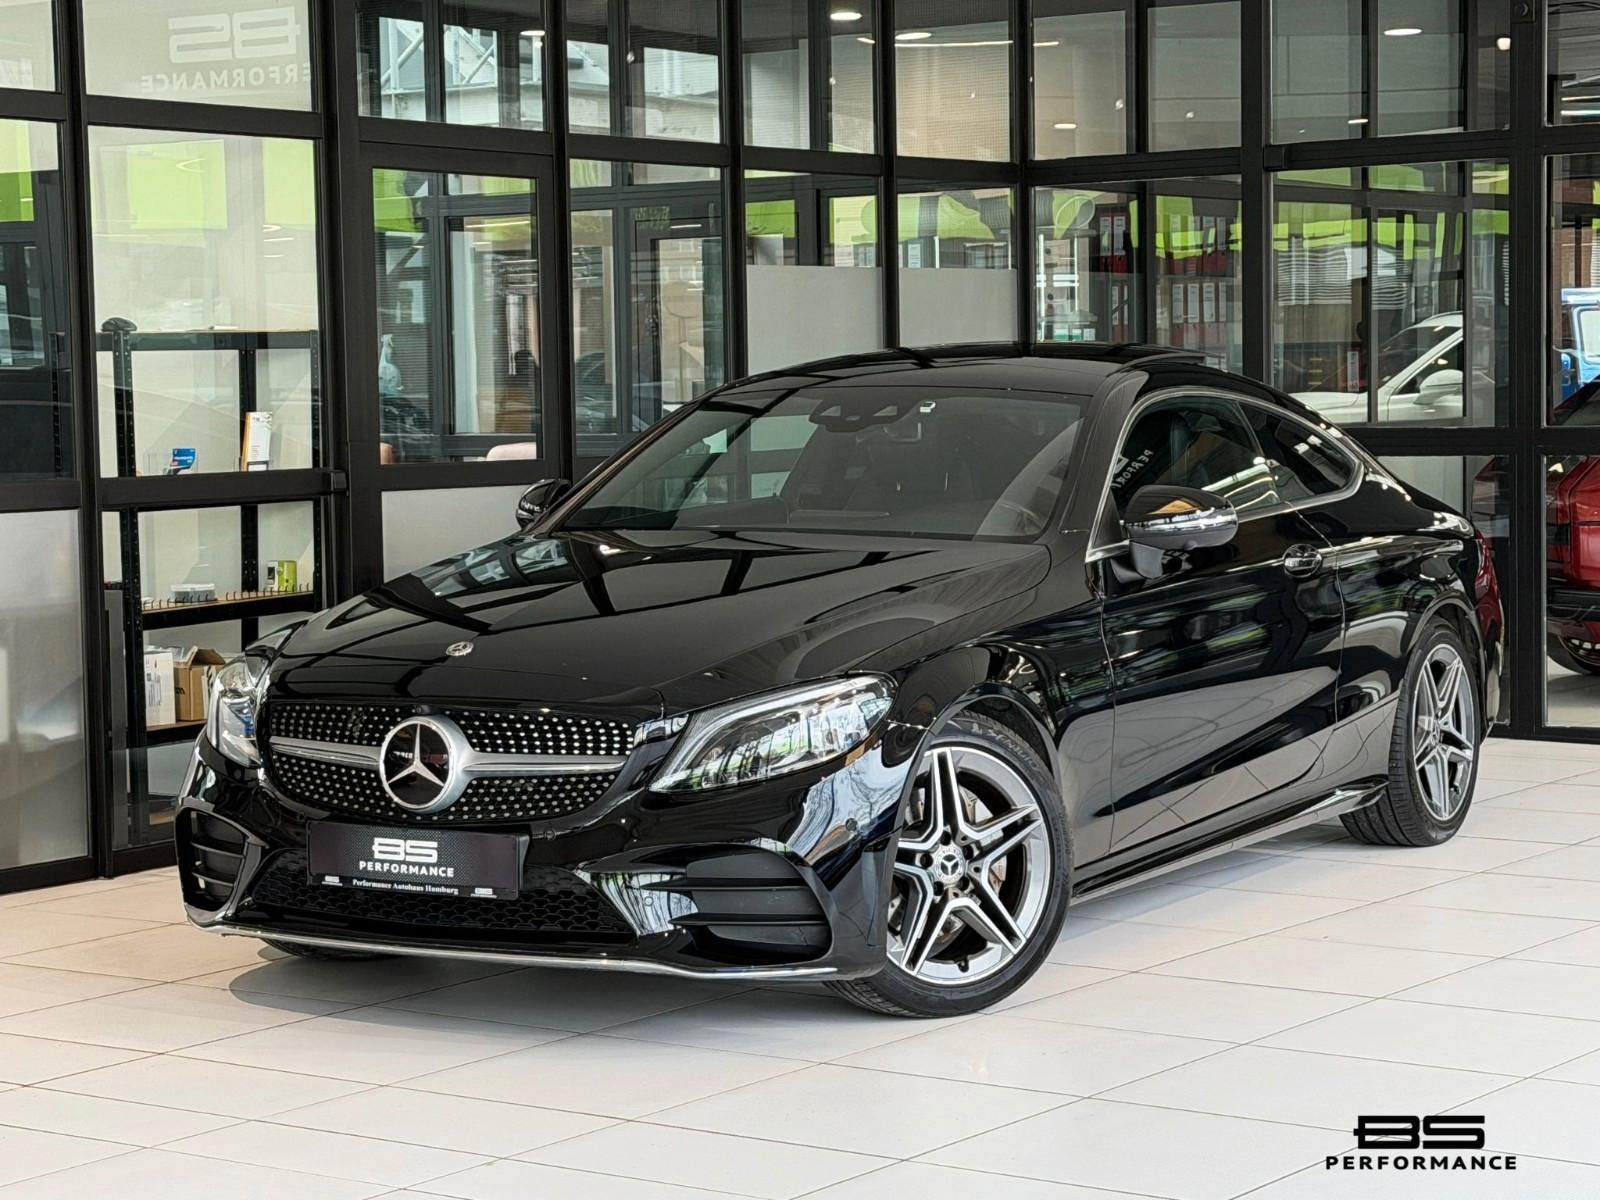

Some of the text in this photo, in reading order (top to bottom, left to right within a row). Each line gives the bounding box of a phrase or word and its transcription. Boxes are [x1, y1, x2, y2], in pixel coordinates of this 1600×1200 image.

[372, 837, 438, 863] BS
[359, 860, 455, 877] PERFORMANCE
[352, 878, 392, 889] Performance
[393, 882, 424, 892] Autohaus
[425, 884, 459, 896] Hamburg
